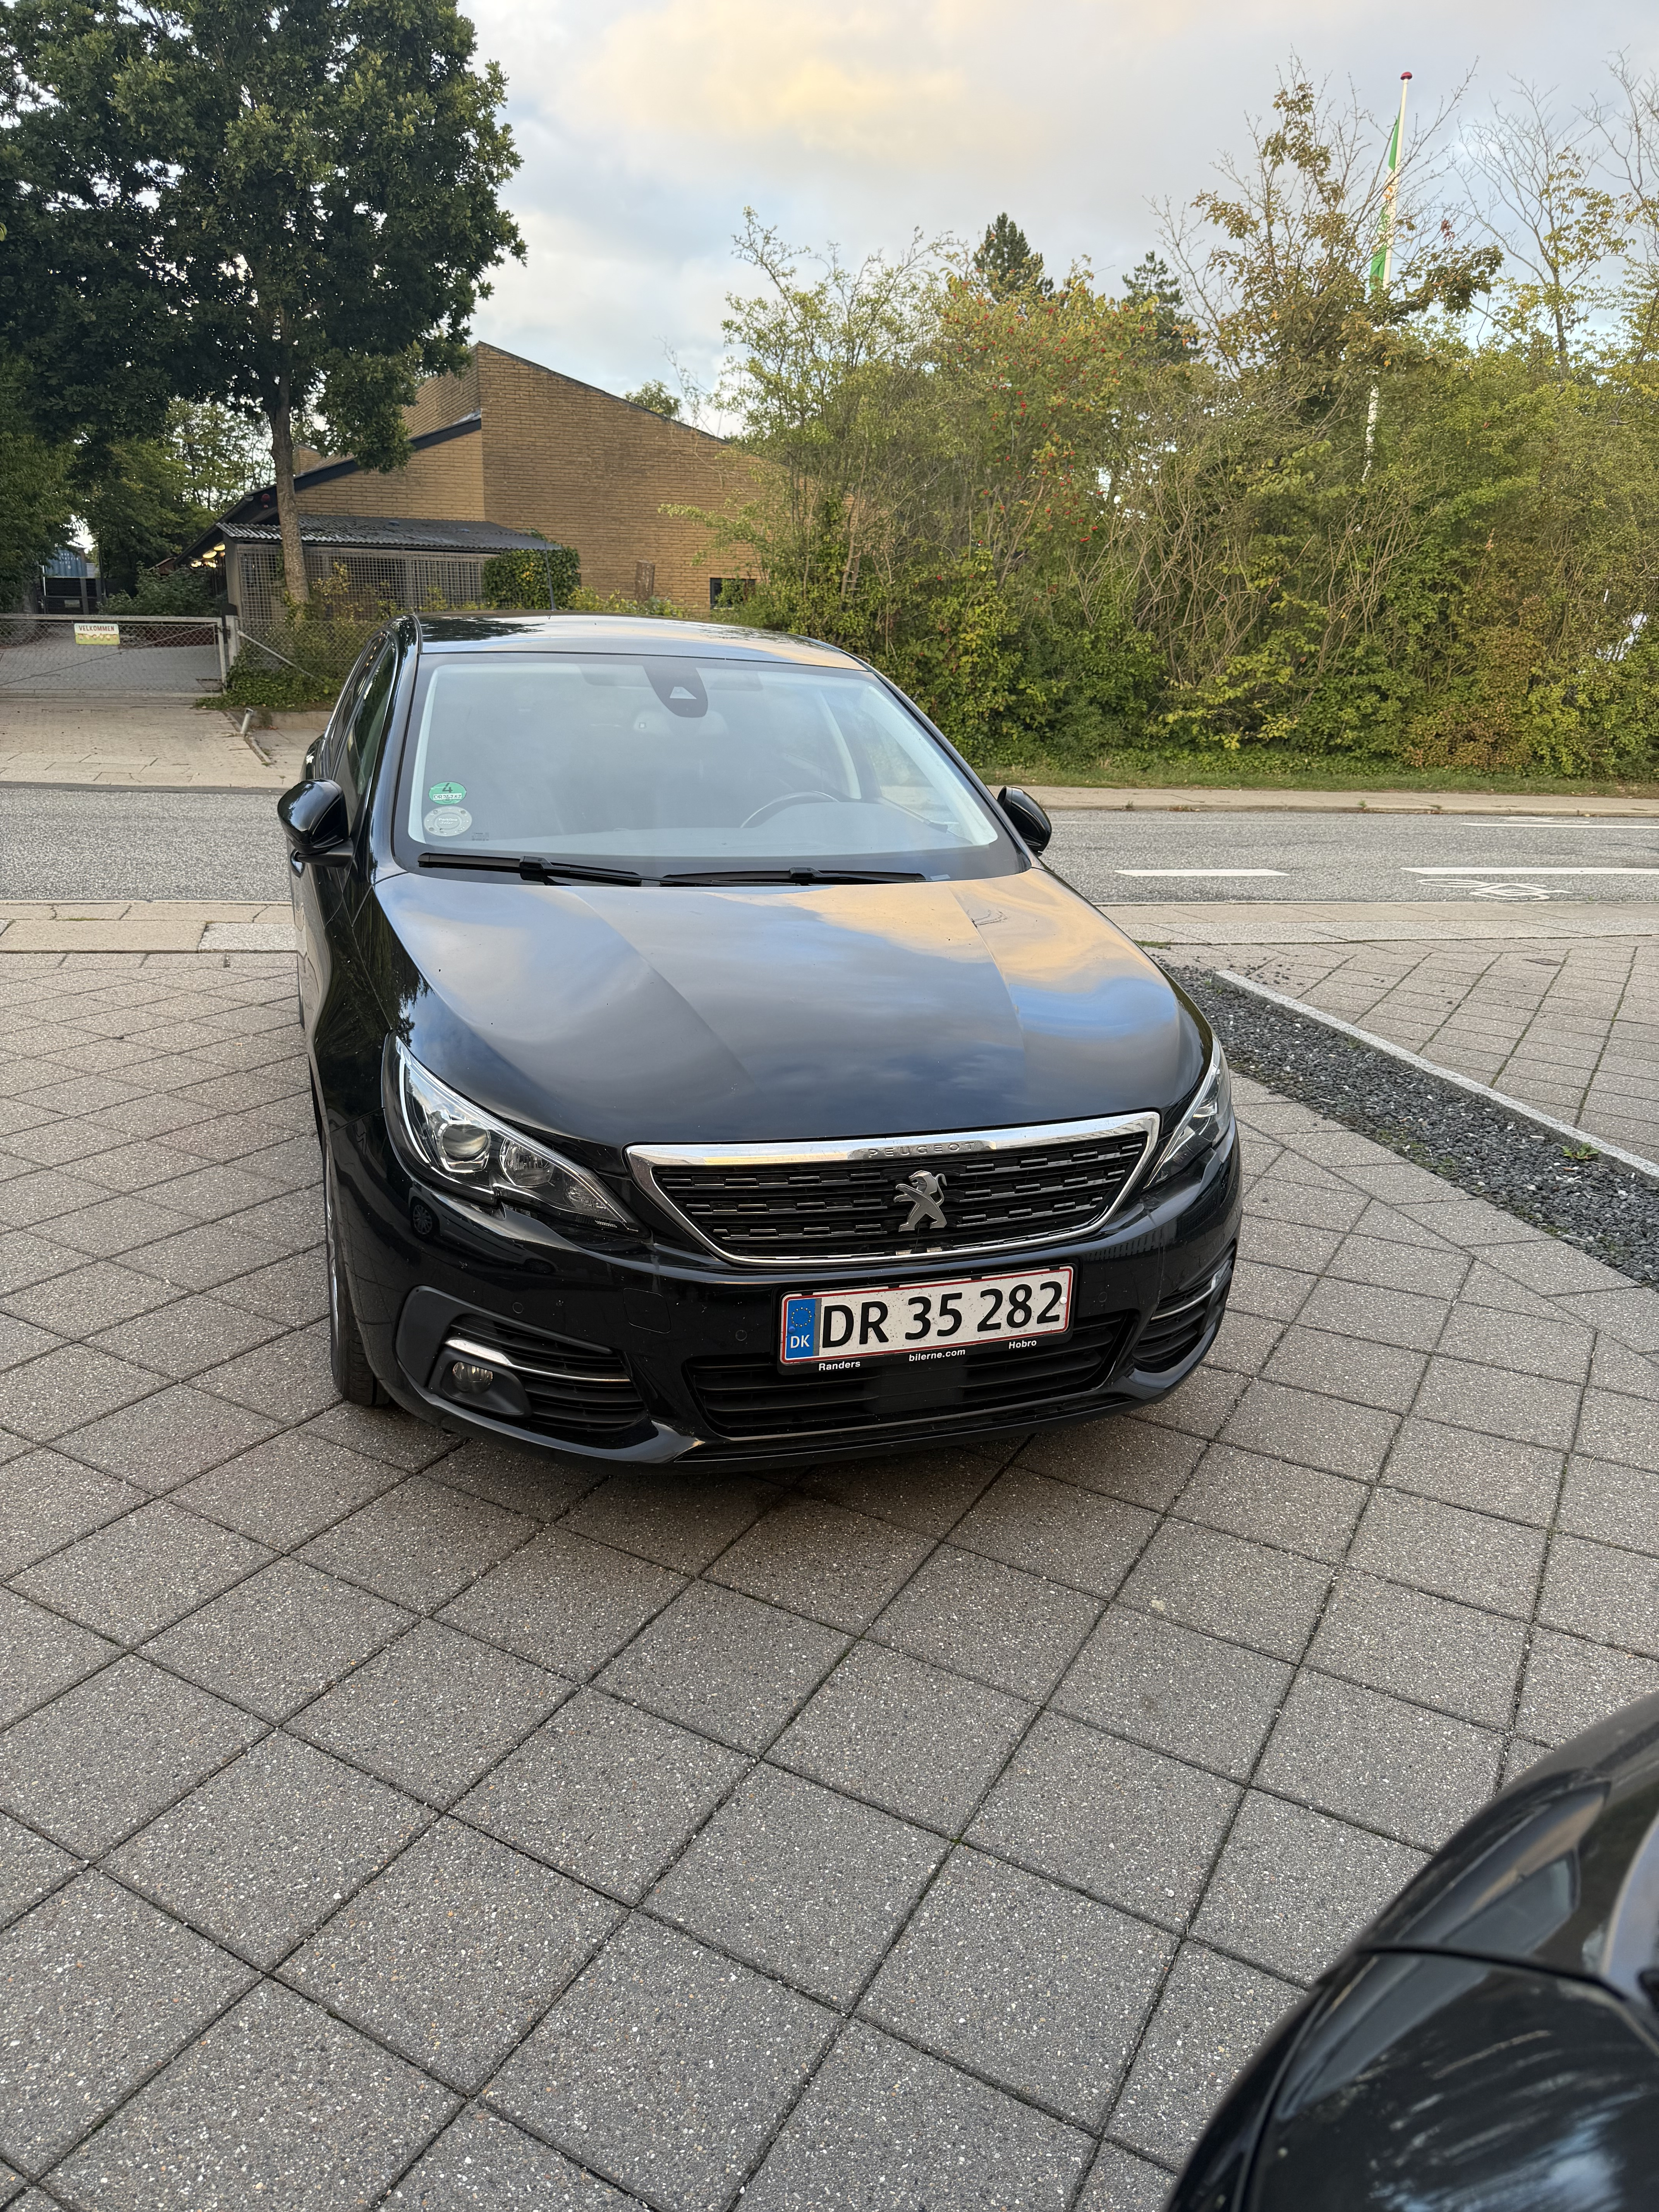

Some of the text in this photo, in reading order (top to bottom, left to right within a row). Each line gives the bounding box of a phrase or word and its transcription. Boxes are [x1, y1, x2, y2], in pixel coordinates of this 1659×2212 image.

[442, 783, 453, 793] 4
[868, 1142, 975, 1158] PEUGEOT
[822, 1281, 1063, 1348] DR 35 282
[790, 1334, 810, 1349] DK
[1008, 1339, 1037, 1350] Hobro
[908, 1348, 966, 1362] bilerne.com
[818, 1360, 861, 1371] Randers
